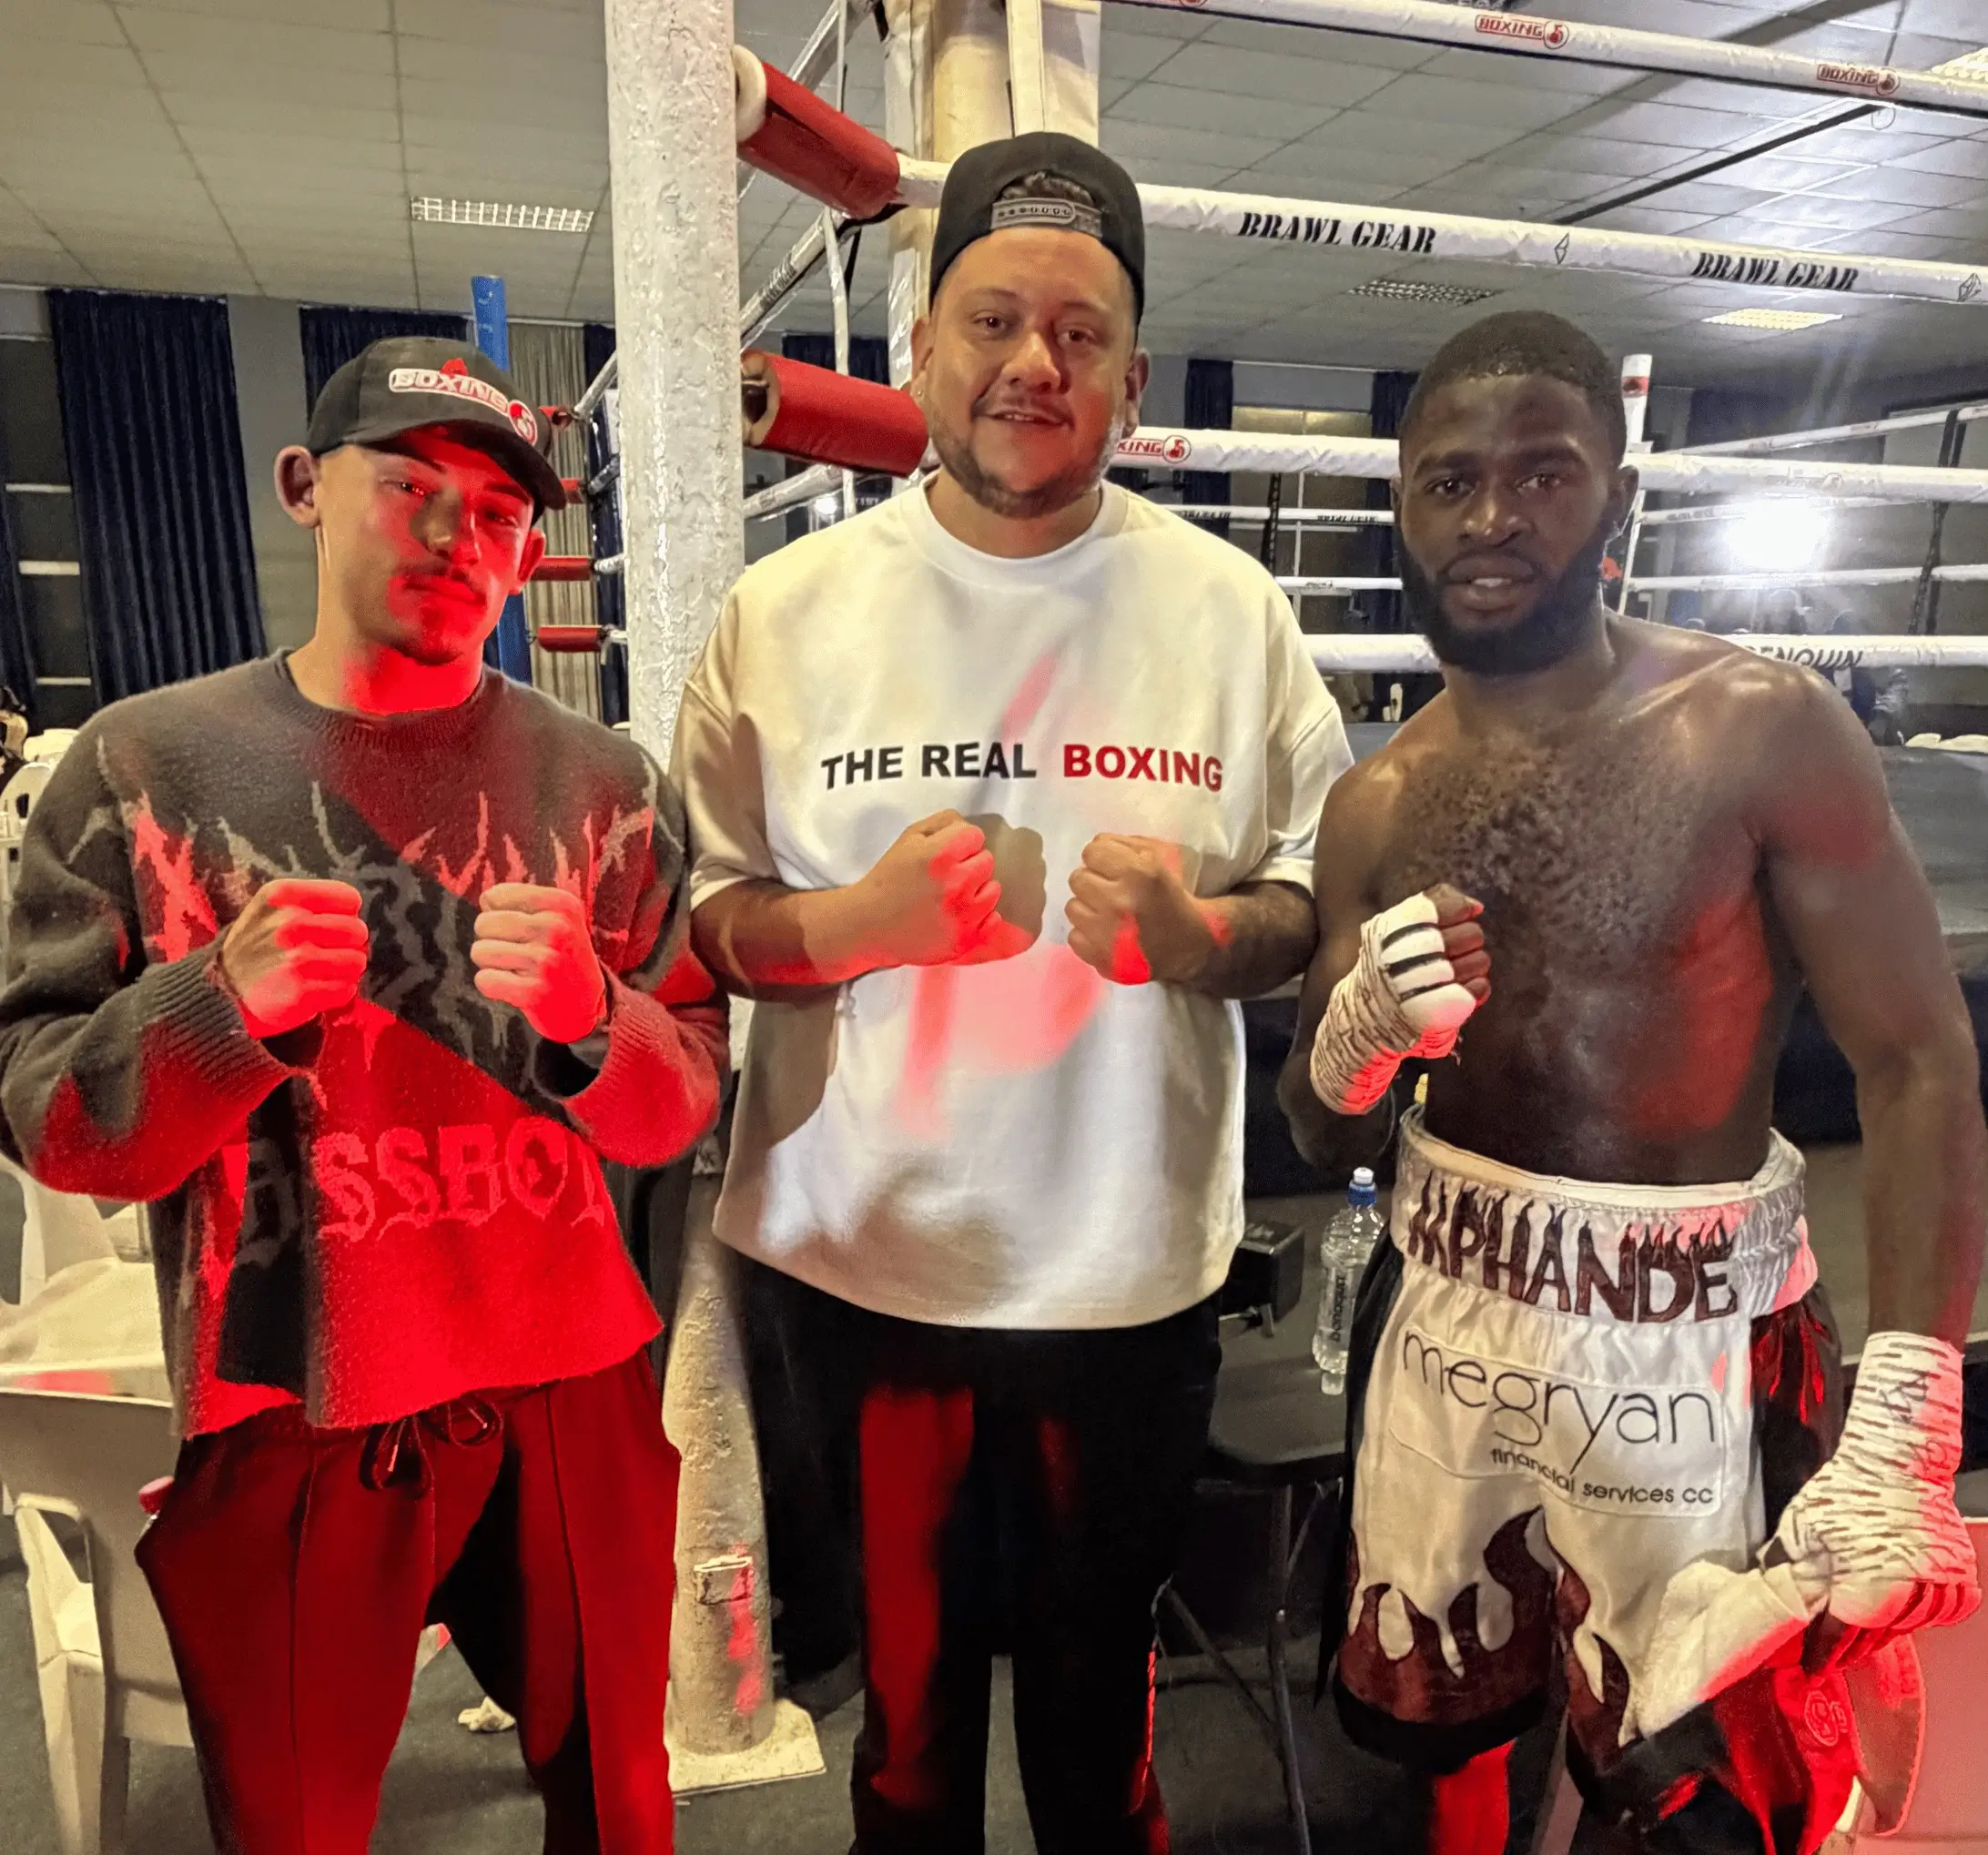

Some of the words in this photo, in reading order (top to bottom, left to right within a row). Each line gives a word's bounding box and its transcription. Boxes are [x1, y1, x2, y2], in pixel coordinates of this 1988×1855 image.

[1478, 17, 1543, 36] BOXING
[1820, 65, 1878, 85] BOXING
[1237, 211, 1342, 246] BRAWL
[1351, 220, 1436, 254] GEAR
[1690, 251, 1780, 286] BRAWL
[1785, 261, 1859, 291] GEAR
[392, 370, 508, 412] BOXING
[820, 745, 904, 790] THE
[921, 742, 1037, 779] REAL
[1062, 744, 1223, 793] BOXING
[1403, 1331, 1715, 1475] megryan
[1490, 1447, 1575, 1493] financial
[1583, 1482, 1675, 1504] services
[1681, 1486, 1714, 1504] cc
